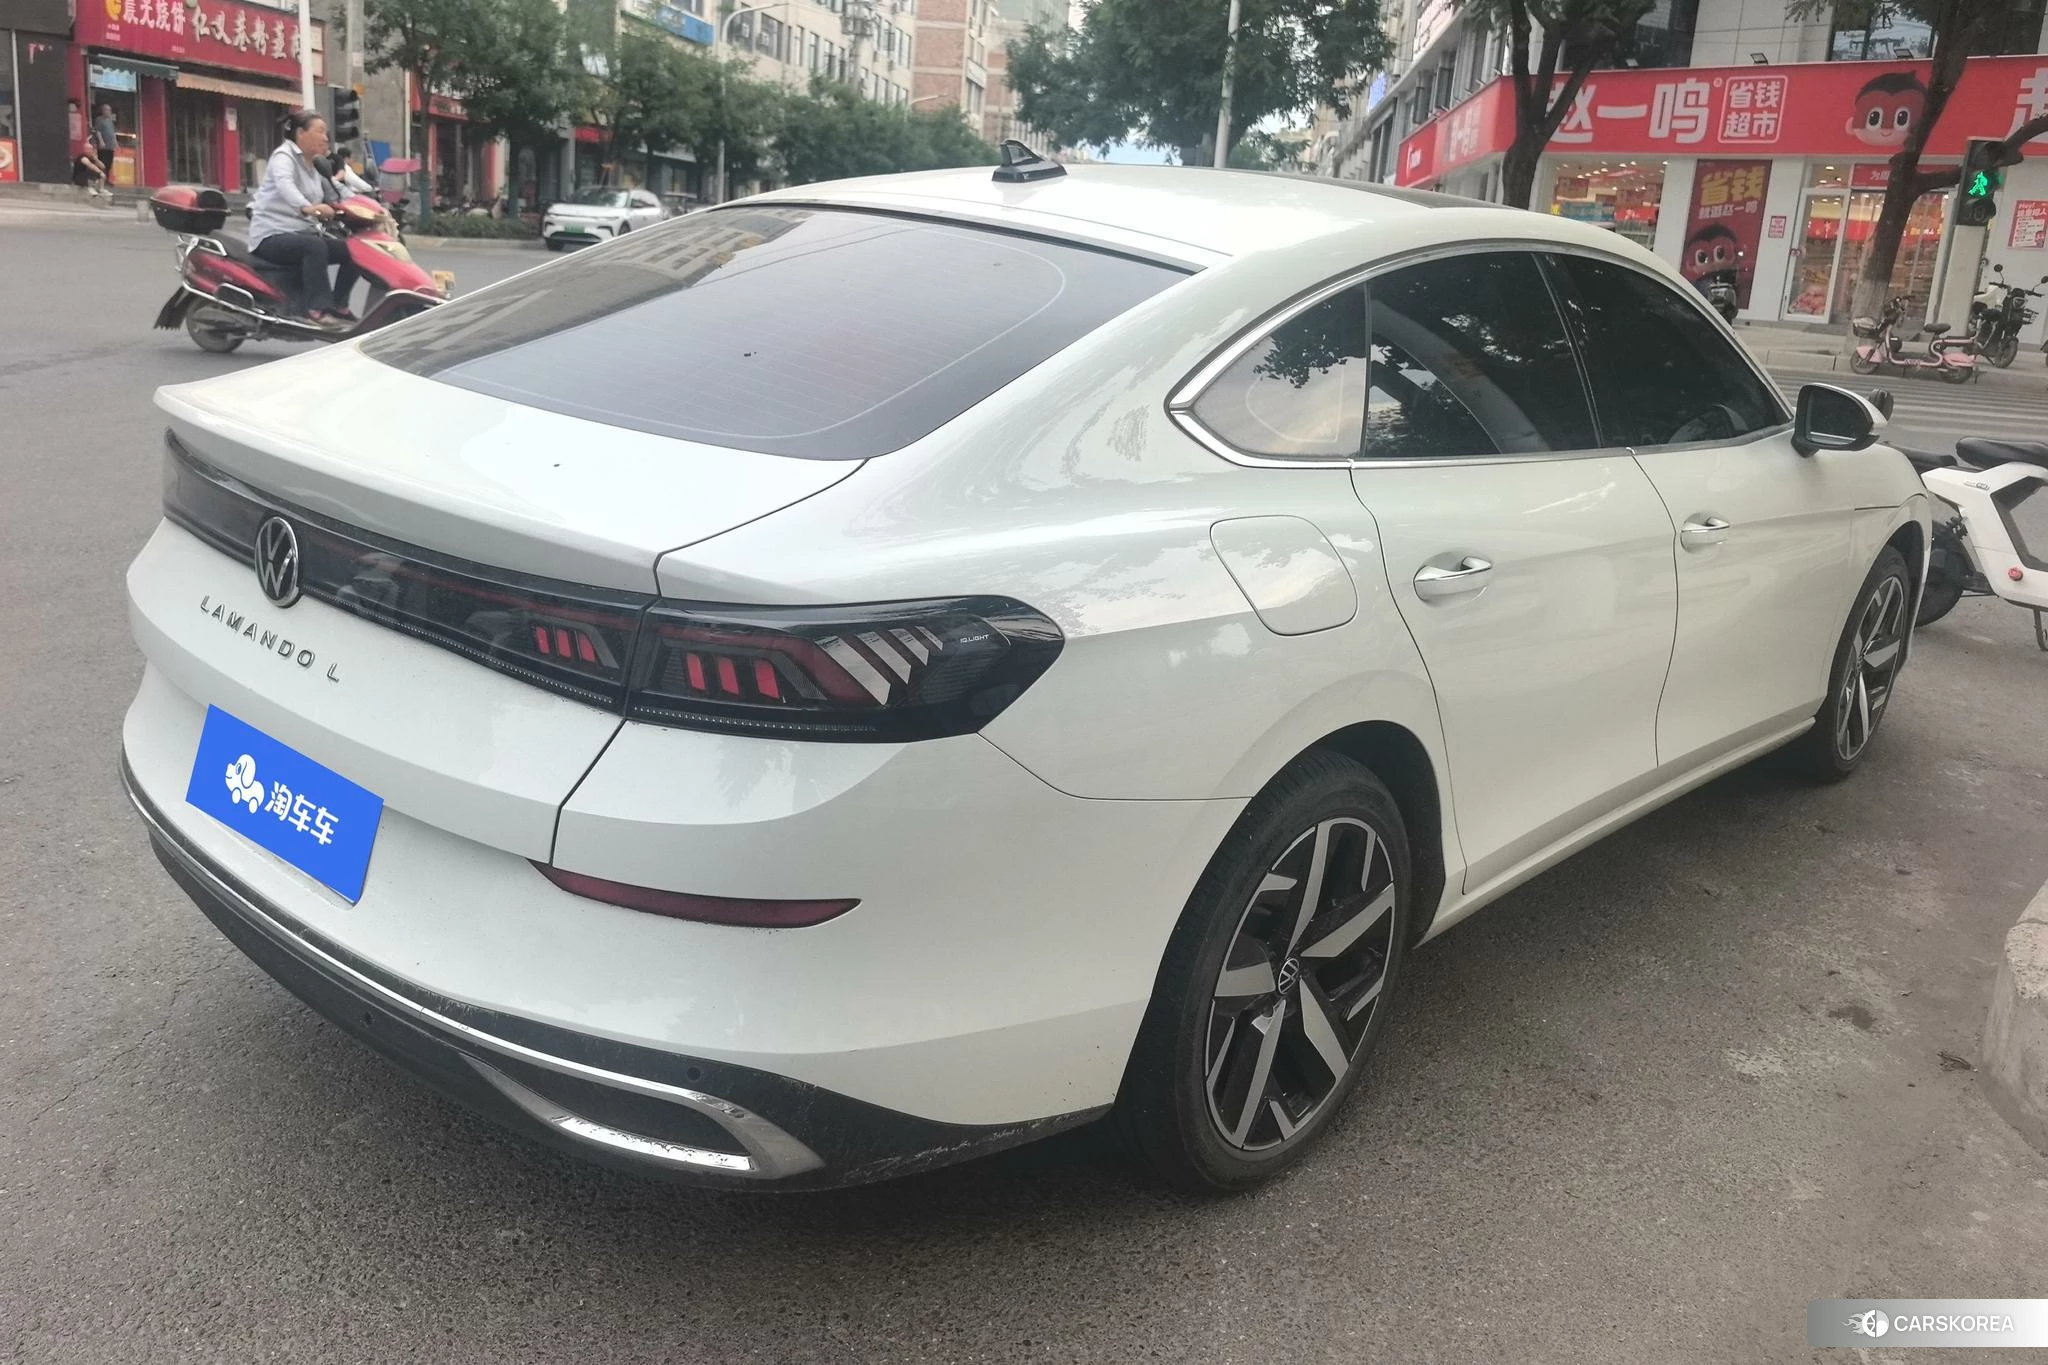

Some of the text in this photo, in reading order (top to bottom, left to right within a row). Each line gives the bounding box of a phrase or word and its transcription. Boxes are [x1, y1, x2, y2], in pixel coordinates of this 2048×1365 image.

[1729, 80, 1780, 109] 省钱
[1724, 111, 1778, 138] 超市
[1701, 165, 1766, 207] 省钱
[200, 595, 340, 683] LAMANDO L
